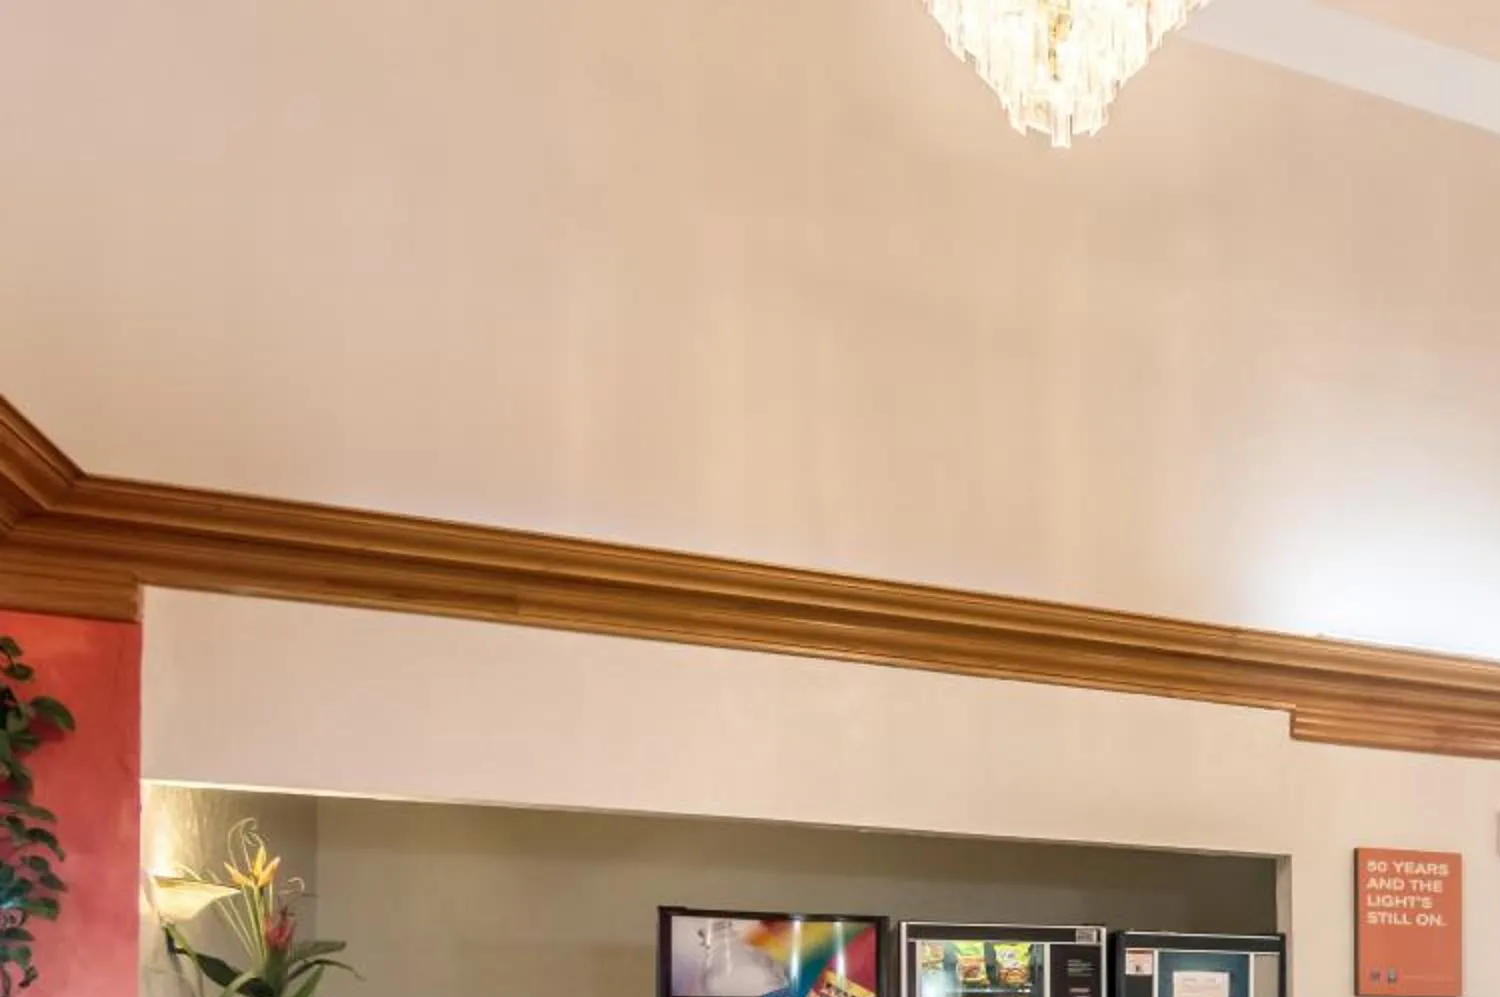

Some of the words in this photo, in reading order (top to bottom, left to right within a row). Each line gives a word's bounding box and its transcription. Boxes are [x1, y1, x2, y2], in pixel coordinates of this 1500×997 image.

[1366, 860, 1387, 873] 50
[1392, 860, 1449, 876] YEARS
[1366, 877, 1405, 891] AND
[1409, 879, 1443, 893] THE
[1366, 894, 1433, 909] LIGHT'S
[1367, 912, 1412, 925] STILL
[1415, 913, 1447, 926] ON.
